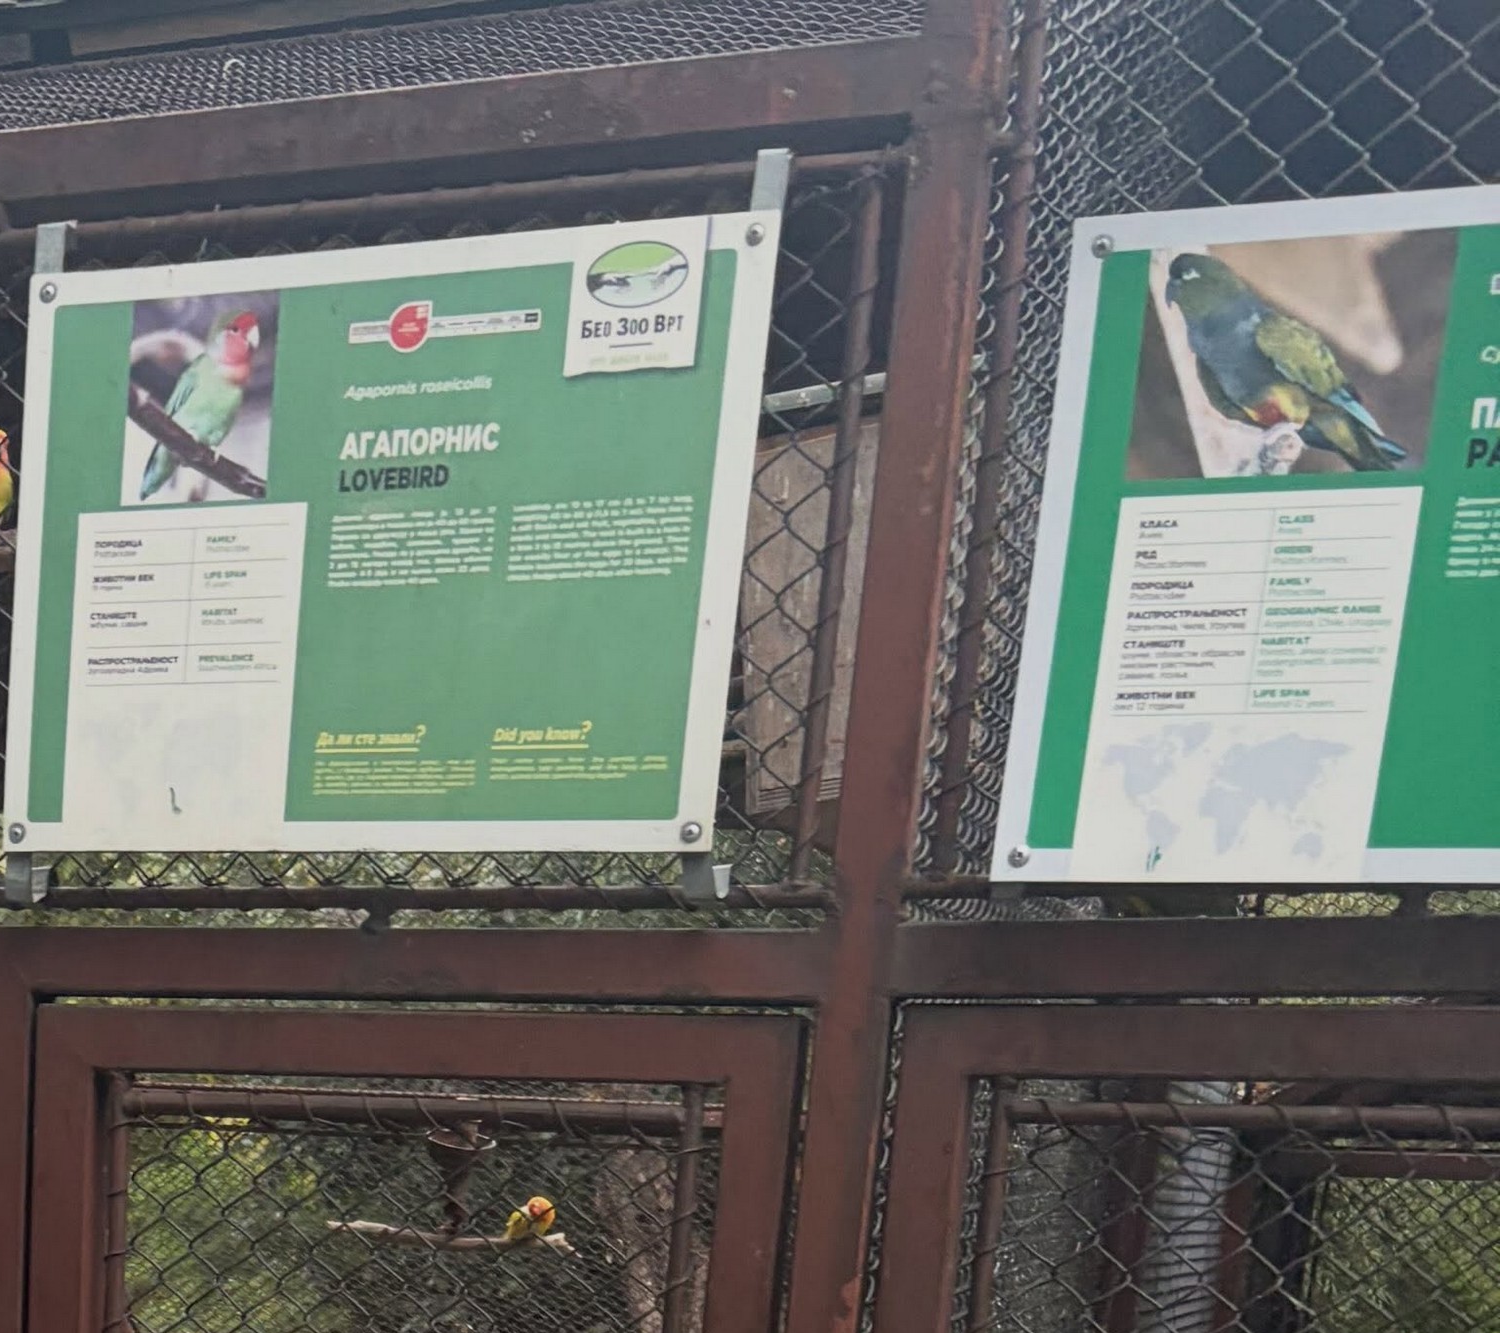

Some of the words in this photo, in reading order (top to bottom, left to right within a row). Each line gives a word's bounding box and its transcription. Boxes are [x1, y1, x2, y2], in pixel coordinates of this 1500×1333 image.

[343, 384, 417, 401] Agapornis
[419, 375, 493, 394] roseicollis
[339, 422, 501, 460] АГАПОРНИС
[339, 464, 449, 492] LOVEBIRD
[1140, 520, 1178, 529] КЛАСА
[1279, 515, 1314, 524] CLASS
[94, 539, 143, 549] ПОРОДИЦА
[206, 535, 237, 544] FAMILY
[1135, 550, 1157, 559] РЕД
[93, 575, 136, 584] ЖИВОТНИ
[138, 574, 155, 582] ВЕК
[204, 572, 222, 580] LIFE
[224, 571, 247, 579] SPAN
[1131, 581, 1194, 590] ПОРОДИЦА
[1269, 577, 1312, 586] FAMILY
[90, 611, 137, 620] СТАНИШТЕ
[202, 608, 238, 617] HABITAT
[1127, 608, 1247, 620] РАСПРОСТРАЊЕНОСТ
[1265, 606, 1339, 616] GEOGRAPHIC
[1123, 639, 1186, 649] СТАНИШТЕ
[1261, 636, 1311, 646] HABITAT
[88, 655, 179, 666] РАСПРОСТРАЊЕНОСТ
[198, 654, 254, 663] PREVALENCE
[1115, 692, 1173, 701] ЖИВОТНИ
[1175, 691, 1196, 700] ВЕК
[1253, 690, 1276, 699] LIFE
[1280, 689, 1310, 698] SPAN
[315, 732, 334, 747] Да
[355, 734, 376, 745] сте
[377, 724, 427, 744] знали?
[493, 728, 518, 742] Did
[518, 730, 544, 744] you
[545, 720, 592, 741] know?
